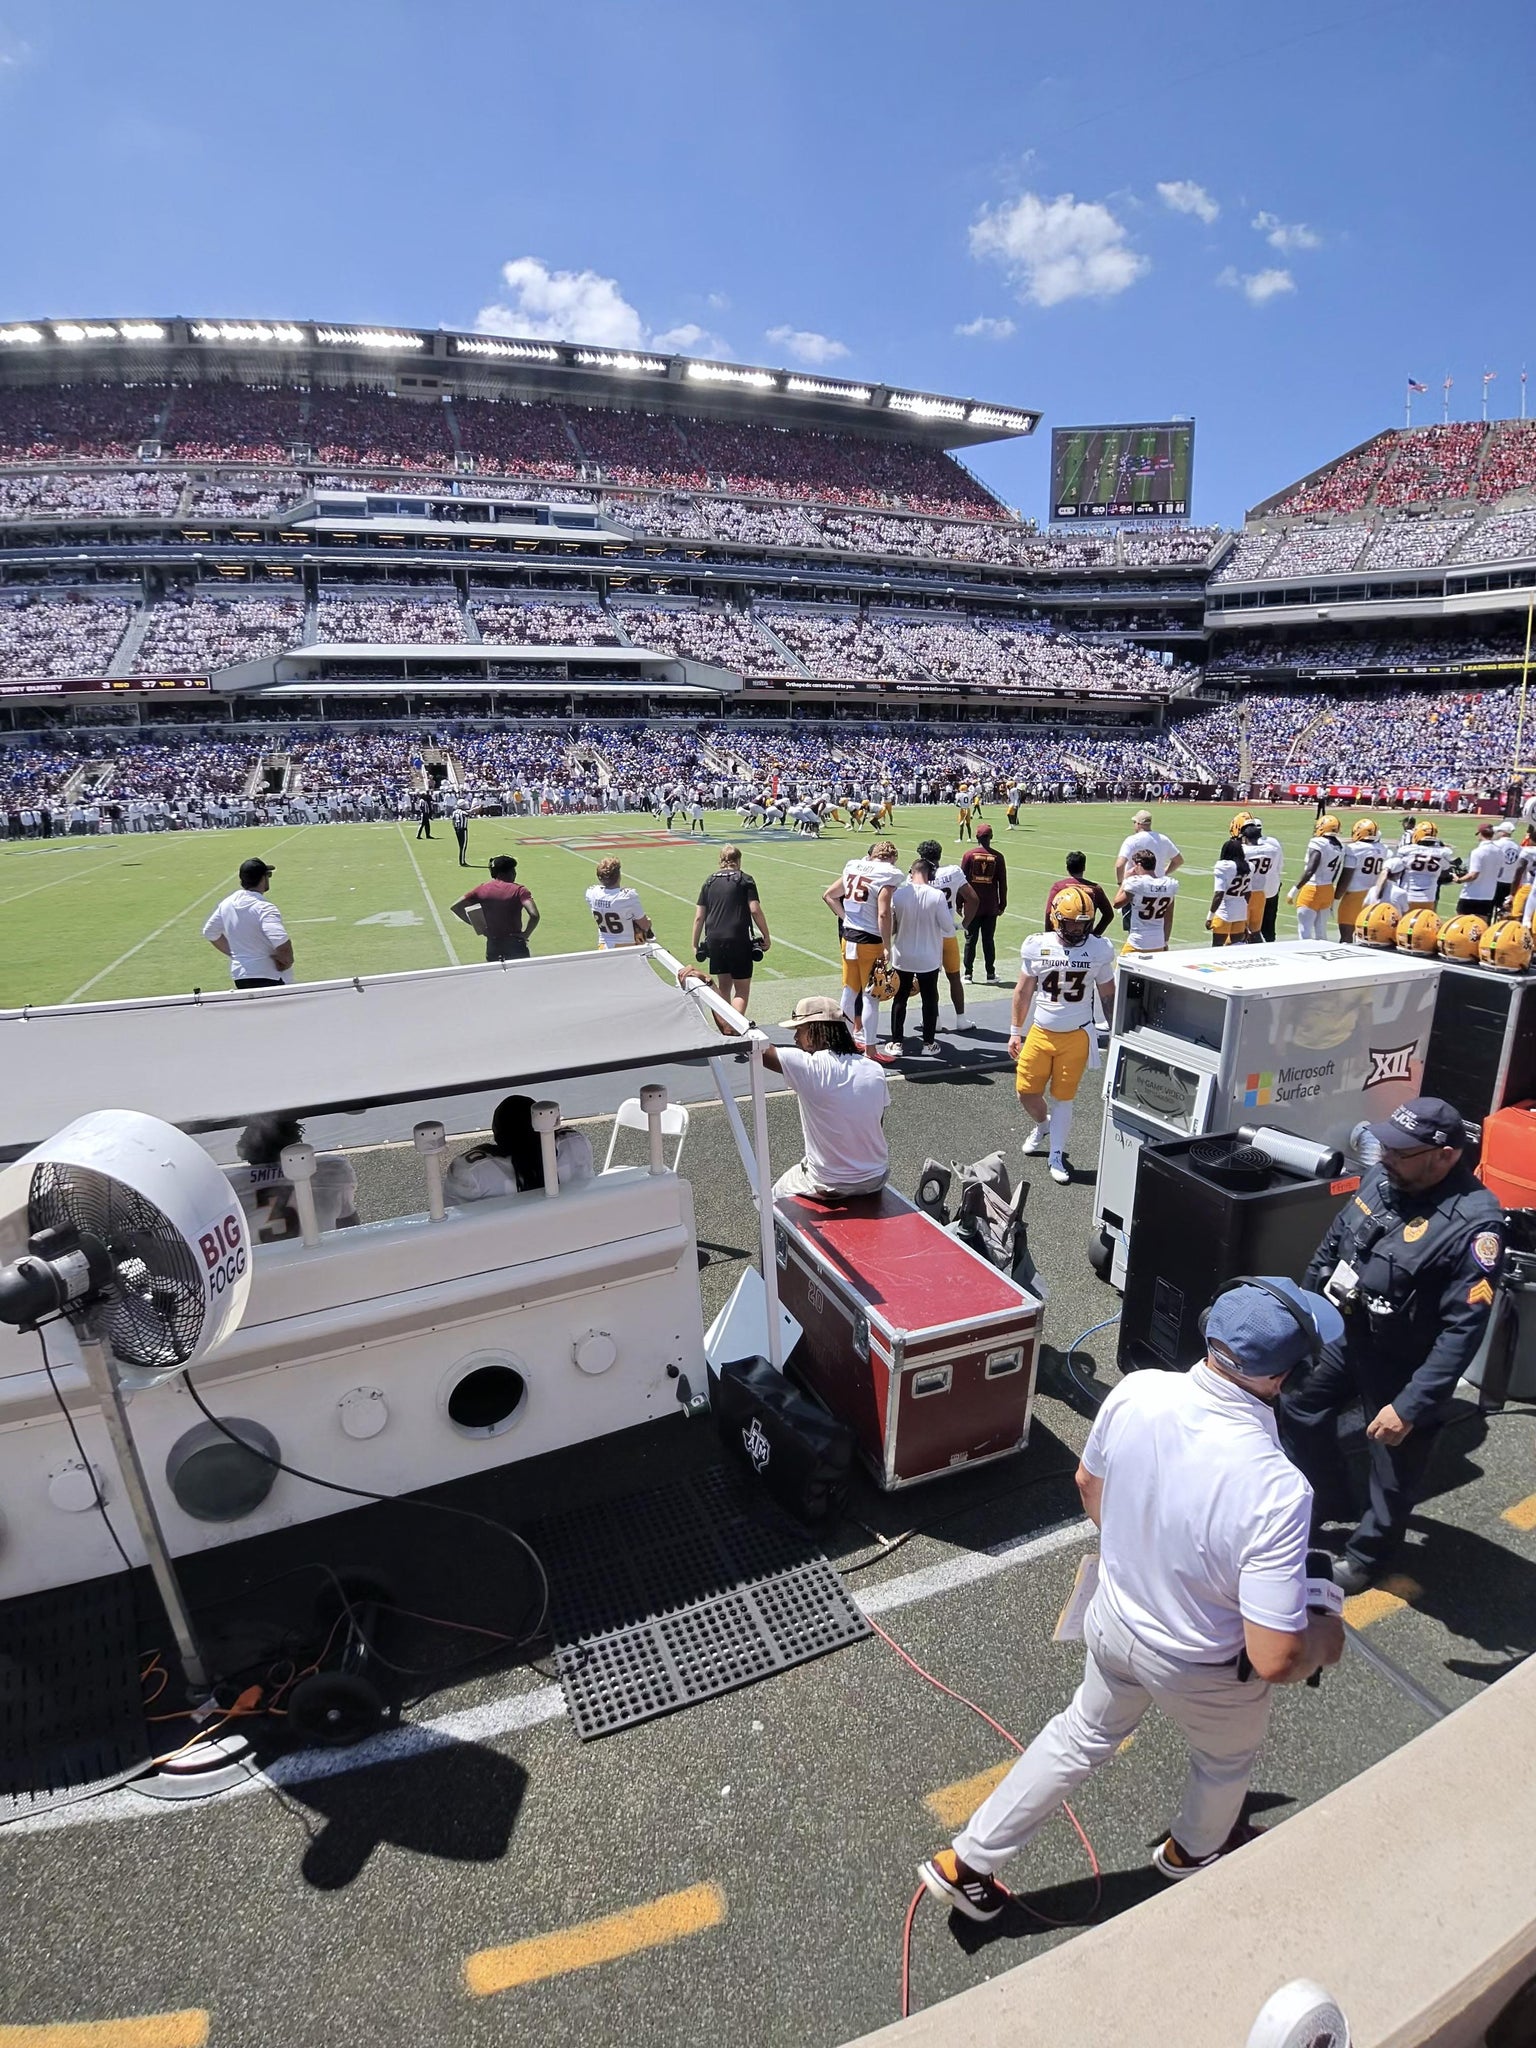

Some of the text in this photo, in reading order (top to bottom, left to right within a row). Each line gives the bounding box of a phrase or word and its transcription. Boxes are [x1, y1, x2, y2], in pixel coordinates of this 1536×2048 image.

[101, 681, 110, 689] 3
[141, 680, 157, 688] 37
[785, 681, 811, 689] Orthopedic
[1411, 854, 1442, 873] 55
[844, 873, 873, 902] 35
[1138, 896, 1171, 920] 32
[592, 910, 624, 934] 26
[1071, 960, 1091, 969] STATE
[1042, 970, 1088, 1003] 43
[1278, 1060, 1335, 1084] Microsoft
[1275, 1083, 1321, 1103] Surface
[1115, 1132, 1133, 1148] DTA
[198, 1214, 241, 1270] BIG
[209, 1246, 246, 1302] FOGG
